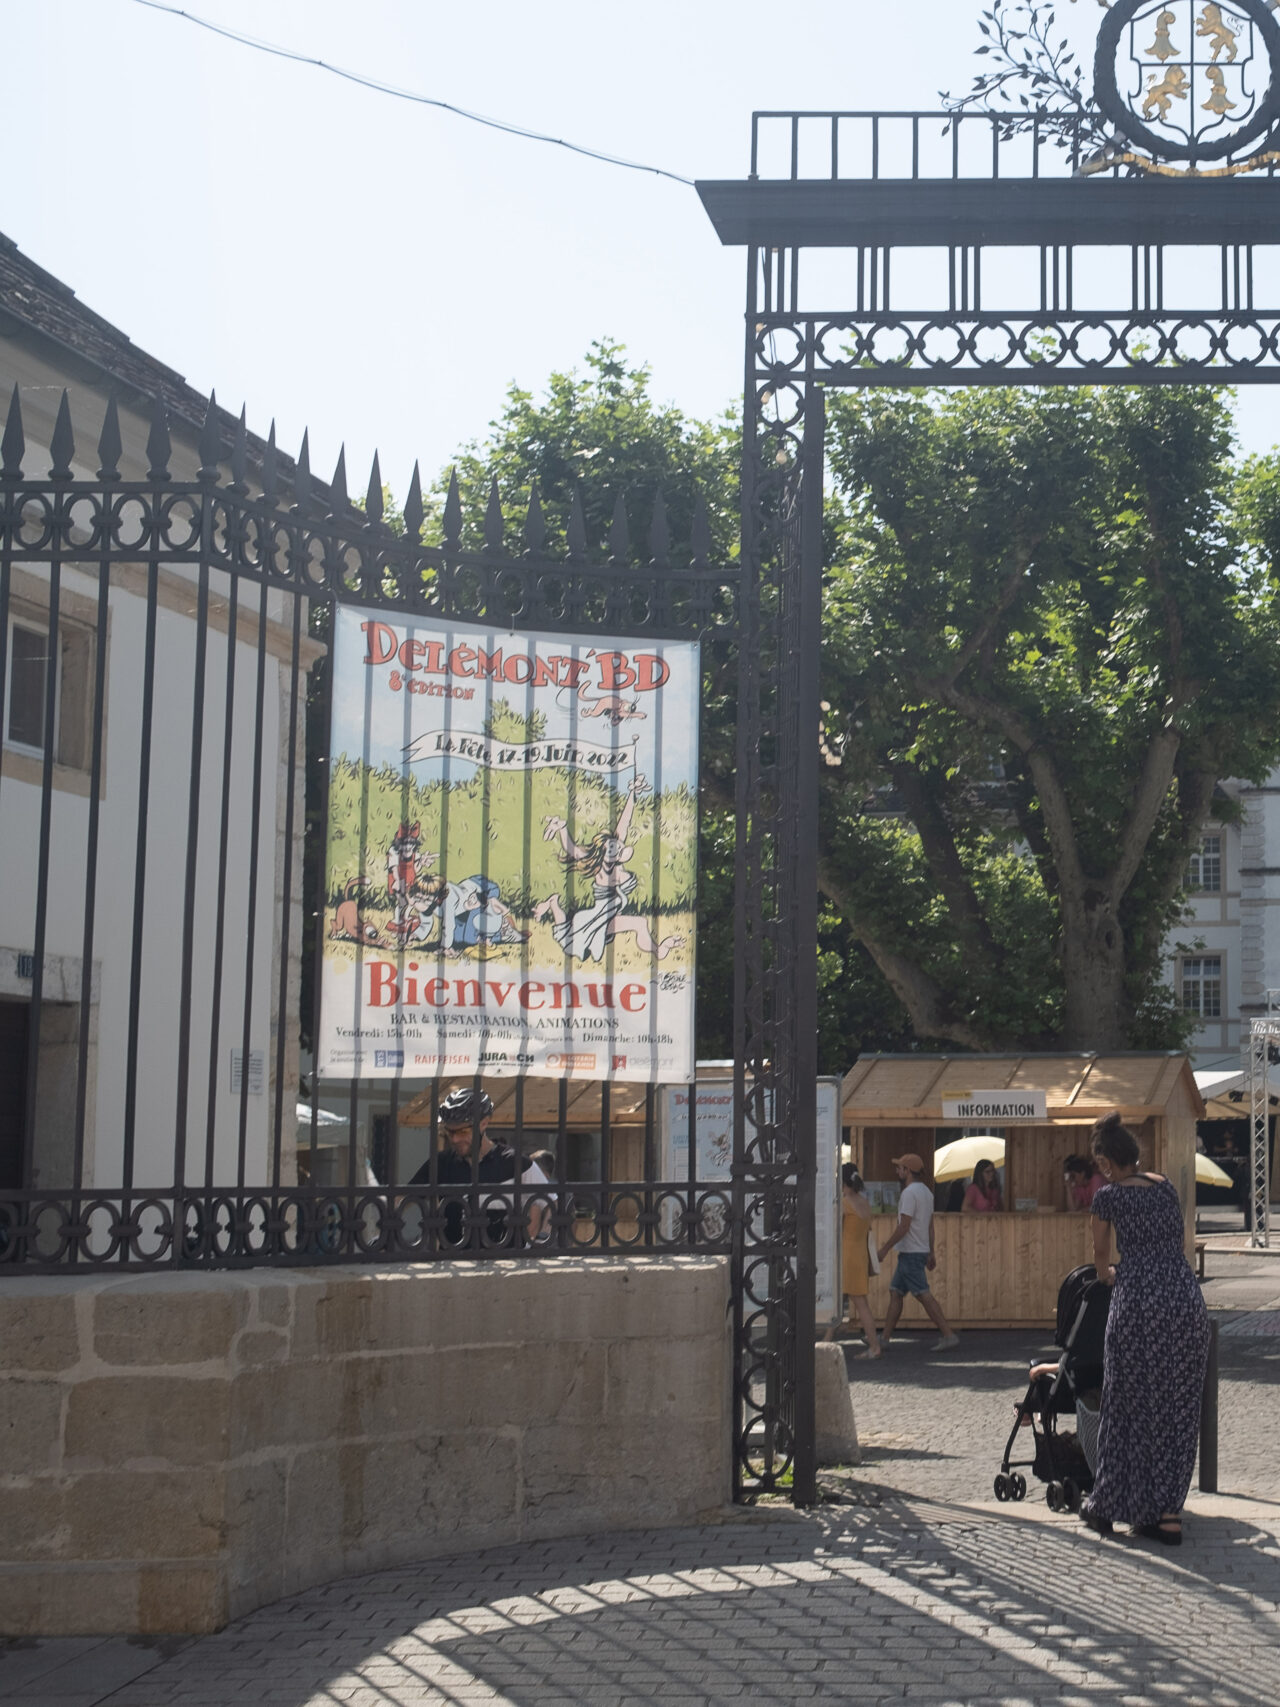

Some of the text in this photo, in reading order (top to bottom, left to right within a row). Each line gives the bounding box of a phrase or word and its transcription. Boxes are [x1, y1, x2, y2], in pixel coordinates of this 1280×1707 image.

[587, 750, 628, 767] 2022
[365, 961, 646, 1012] Bienvenue
[391, 1013, 416, 1025] BAR
[422, 1014, 429, 1024] &
[536, 1017, 619, 1029] ANIMATIONS
[415, 1055, 470, 1064] RAIFFEISEN
[479, 1052, 507, 1062] JURA
[957, 1103, 1035, 1117] INFORMATION
